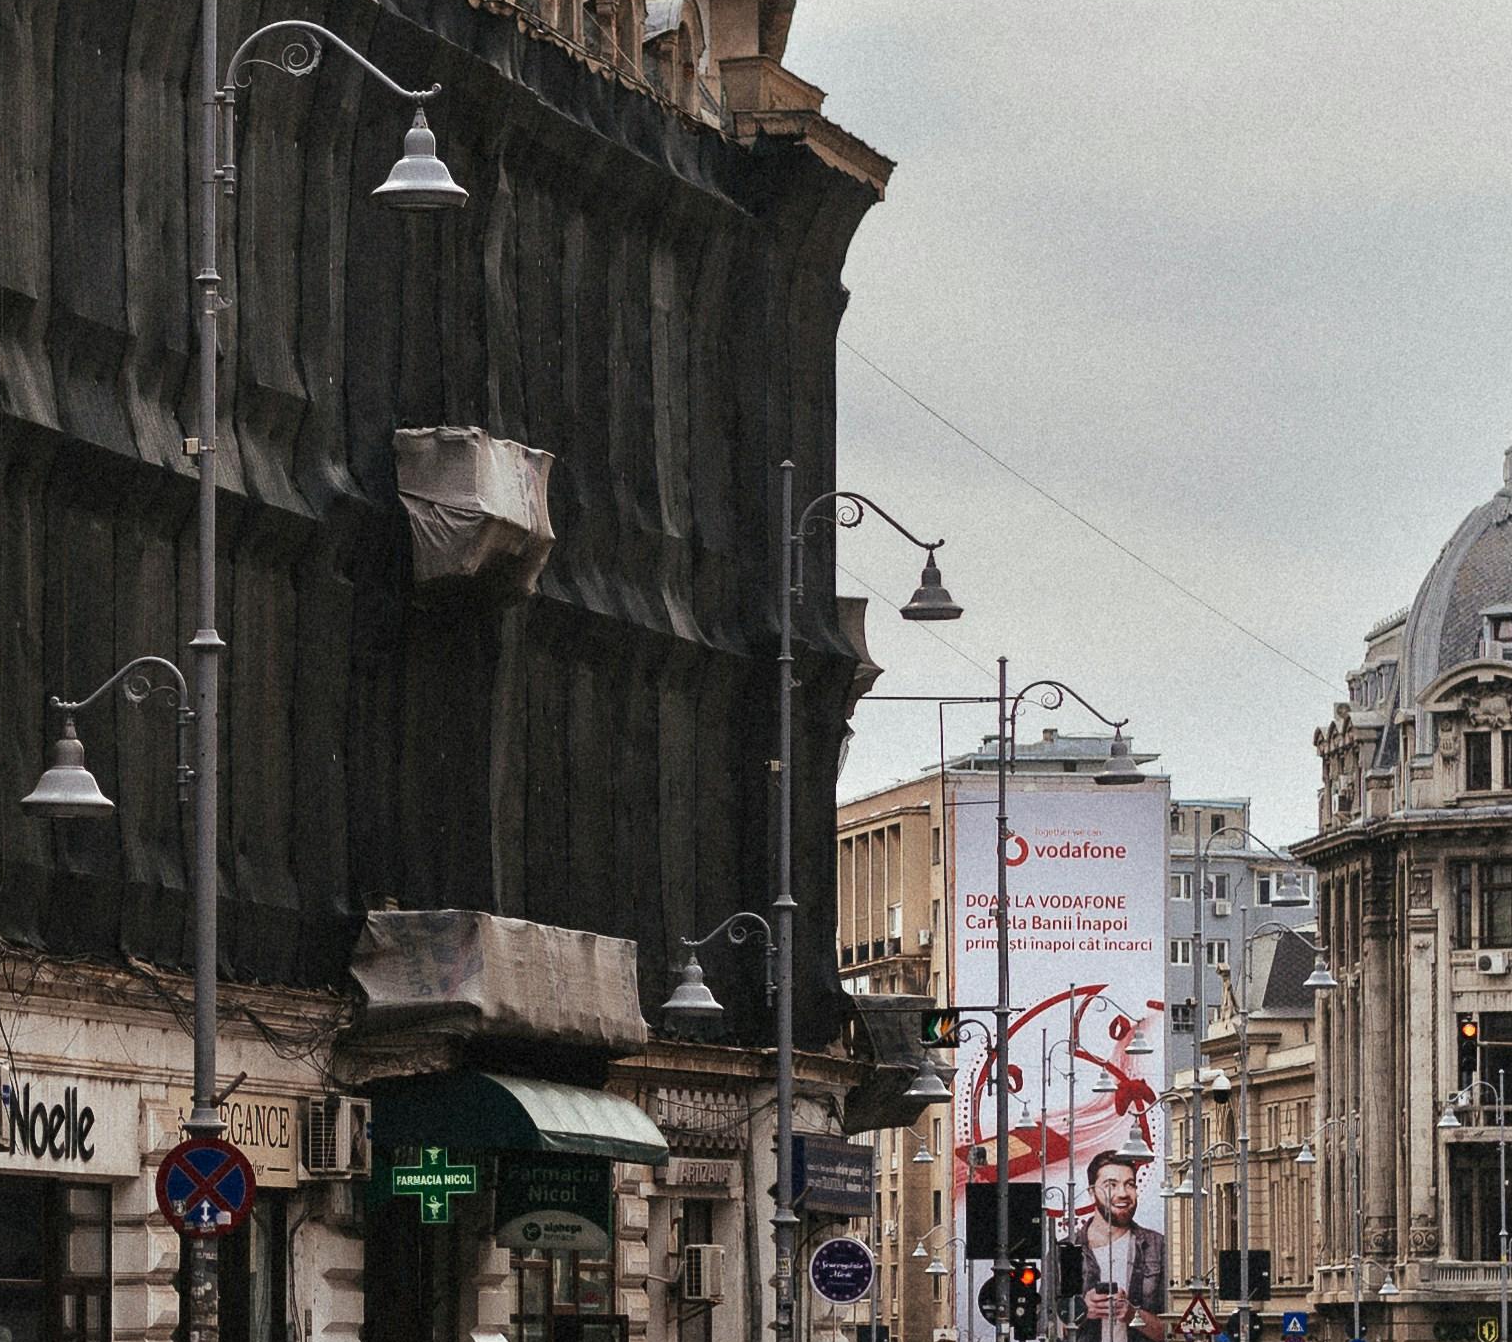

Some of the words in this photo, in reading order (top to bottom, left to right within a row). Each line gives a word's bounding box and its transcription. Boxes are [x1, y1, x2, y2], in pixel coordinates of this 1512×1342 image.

[1034, 841, 1127, 859] vodafone
[1015, 895, 1035, 908] LA
[1039, 895, 1126, 909] VODAFONE
[1032, 915, 1072, 930] Banii
[965, 937, 1026, 952] primști
[9, 1082, 95, 1163] Noelle
[396, 1174, 442, 1186] FARMACIA
[444, 1174, 472, 1185] NICOL
[510, 1163, 600, 1183] Farmacia
[527, 1184, 578, 1203] Nicol
